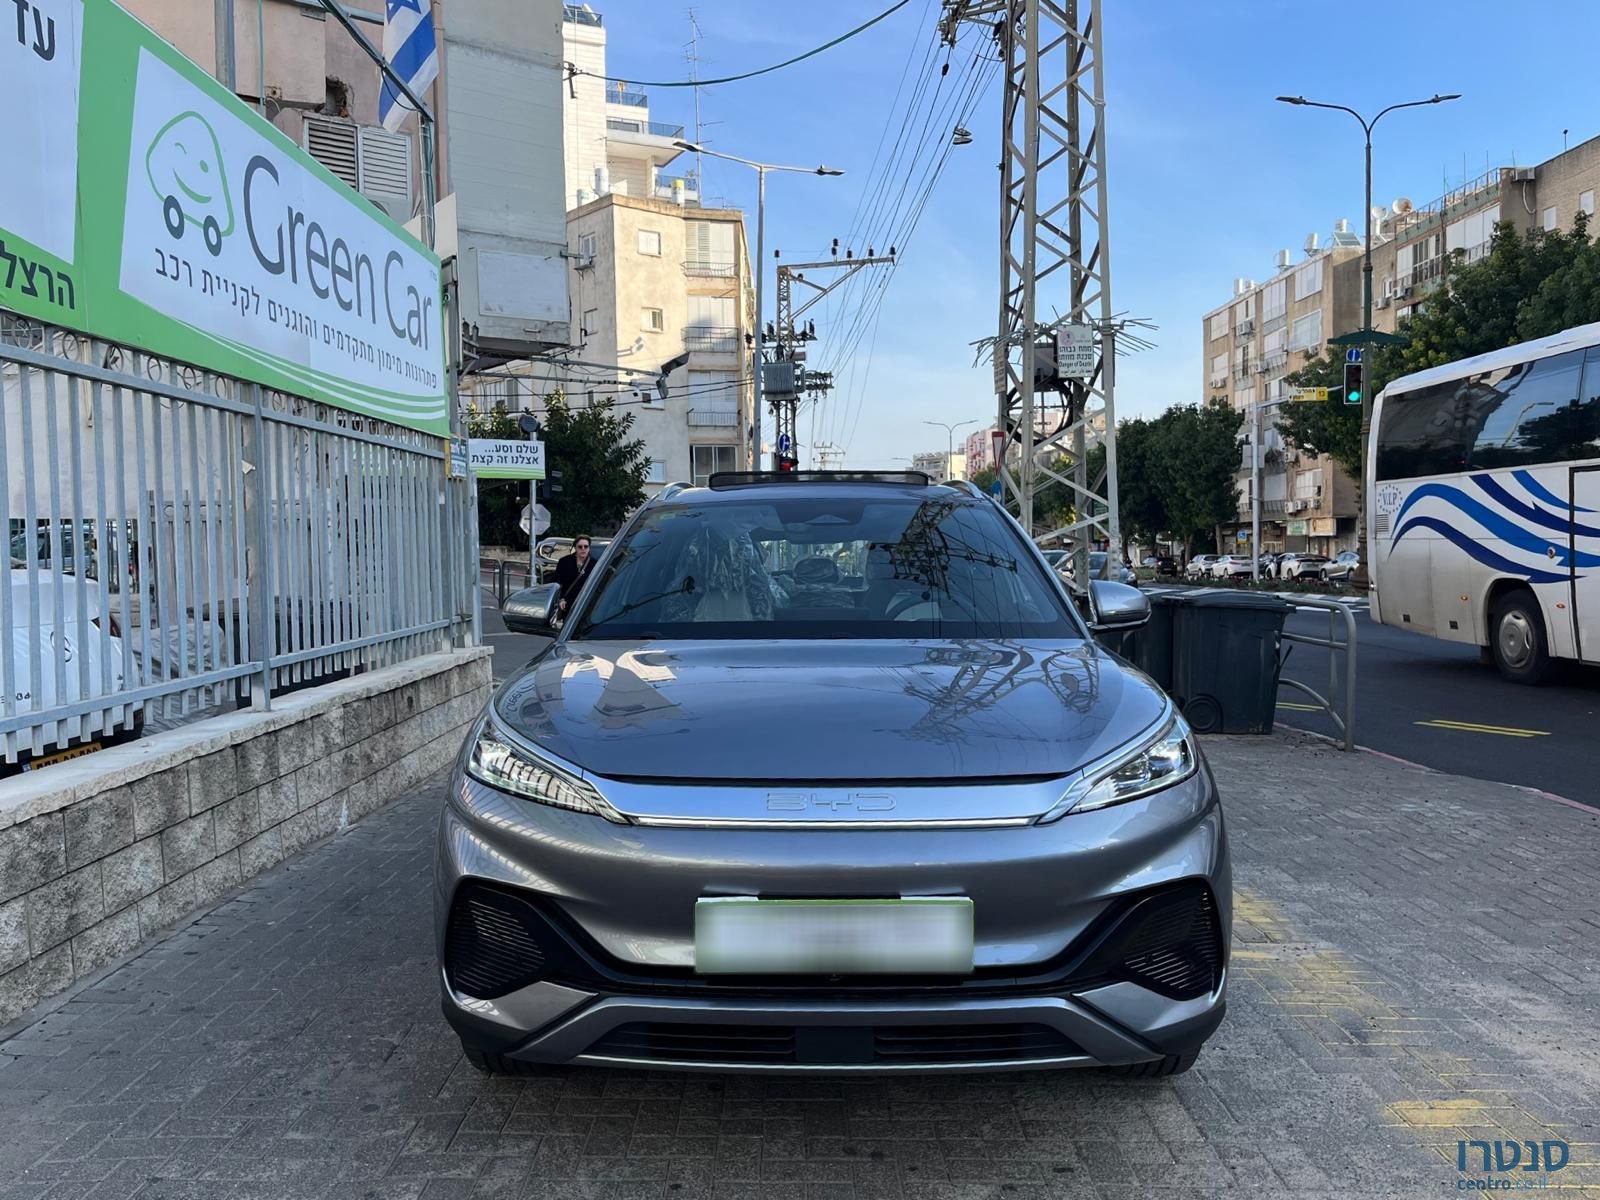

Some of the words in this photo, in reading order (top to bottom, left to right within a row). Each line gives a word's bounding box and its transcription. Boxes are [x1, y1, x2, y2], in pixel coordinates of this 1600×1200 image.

[243, 154, 377, 325] Green
[384, 250, 432, 350] Car
[155, 247, 193, 288] רכב
[201, 269, 260, 317] לקניית
[267, 299, 318, 340] והוגנים
[323, 323, 374, 363] מתקדמים
[377, 348, 402, 374] מימון
[405, 360, 437, 389] פתרונות
[472, 454, 494, 466] קצת
[484, 444, 513, 453] וסע...
[496, 455, 508, 464] זה
[511, 455, 539, 465] אצלנו
[516, 444, 539, 454] שלם
[767, 792, 897, 812] BYD
